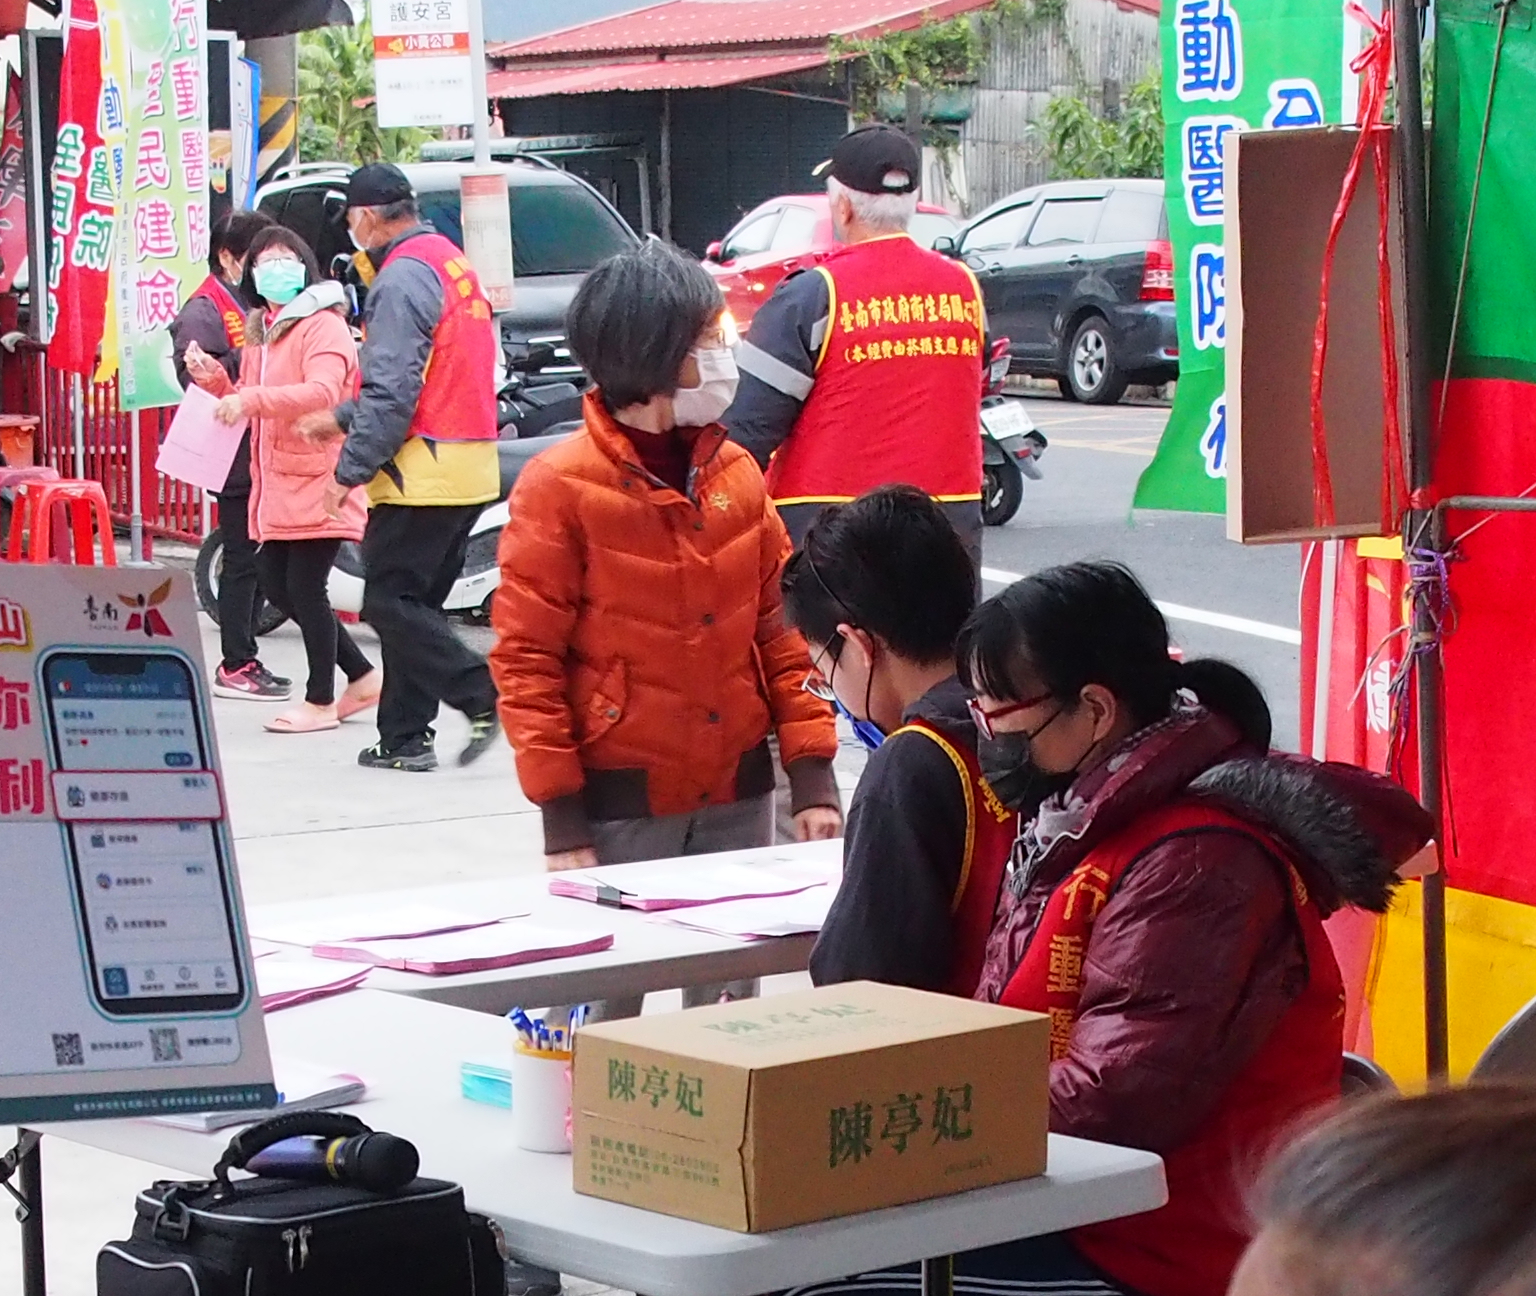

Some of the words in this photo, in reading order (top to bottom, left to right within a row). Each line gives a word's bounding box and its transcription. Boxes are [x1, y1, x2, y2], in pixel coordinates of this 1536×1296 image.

[390, 1, 452, 22] 護安宮
[134, 60, 180, 330] 全民健檢
[608, 1057, 704, 1118] 陳亭妃
[828, 1082, 974, 1169] 陳亭妃
